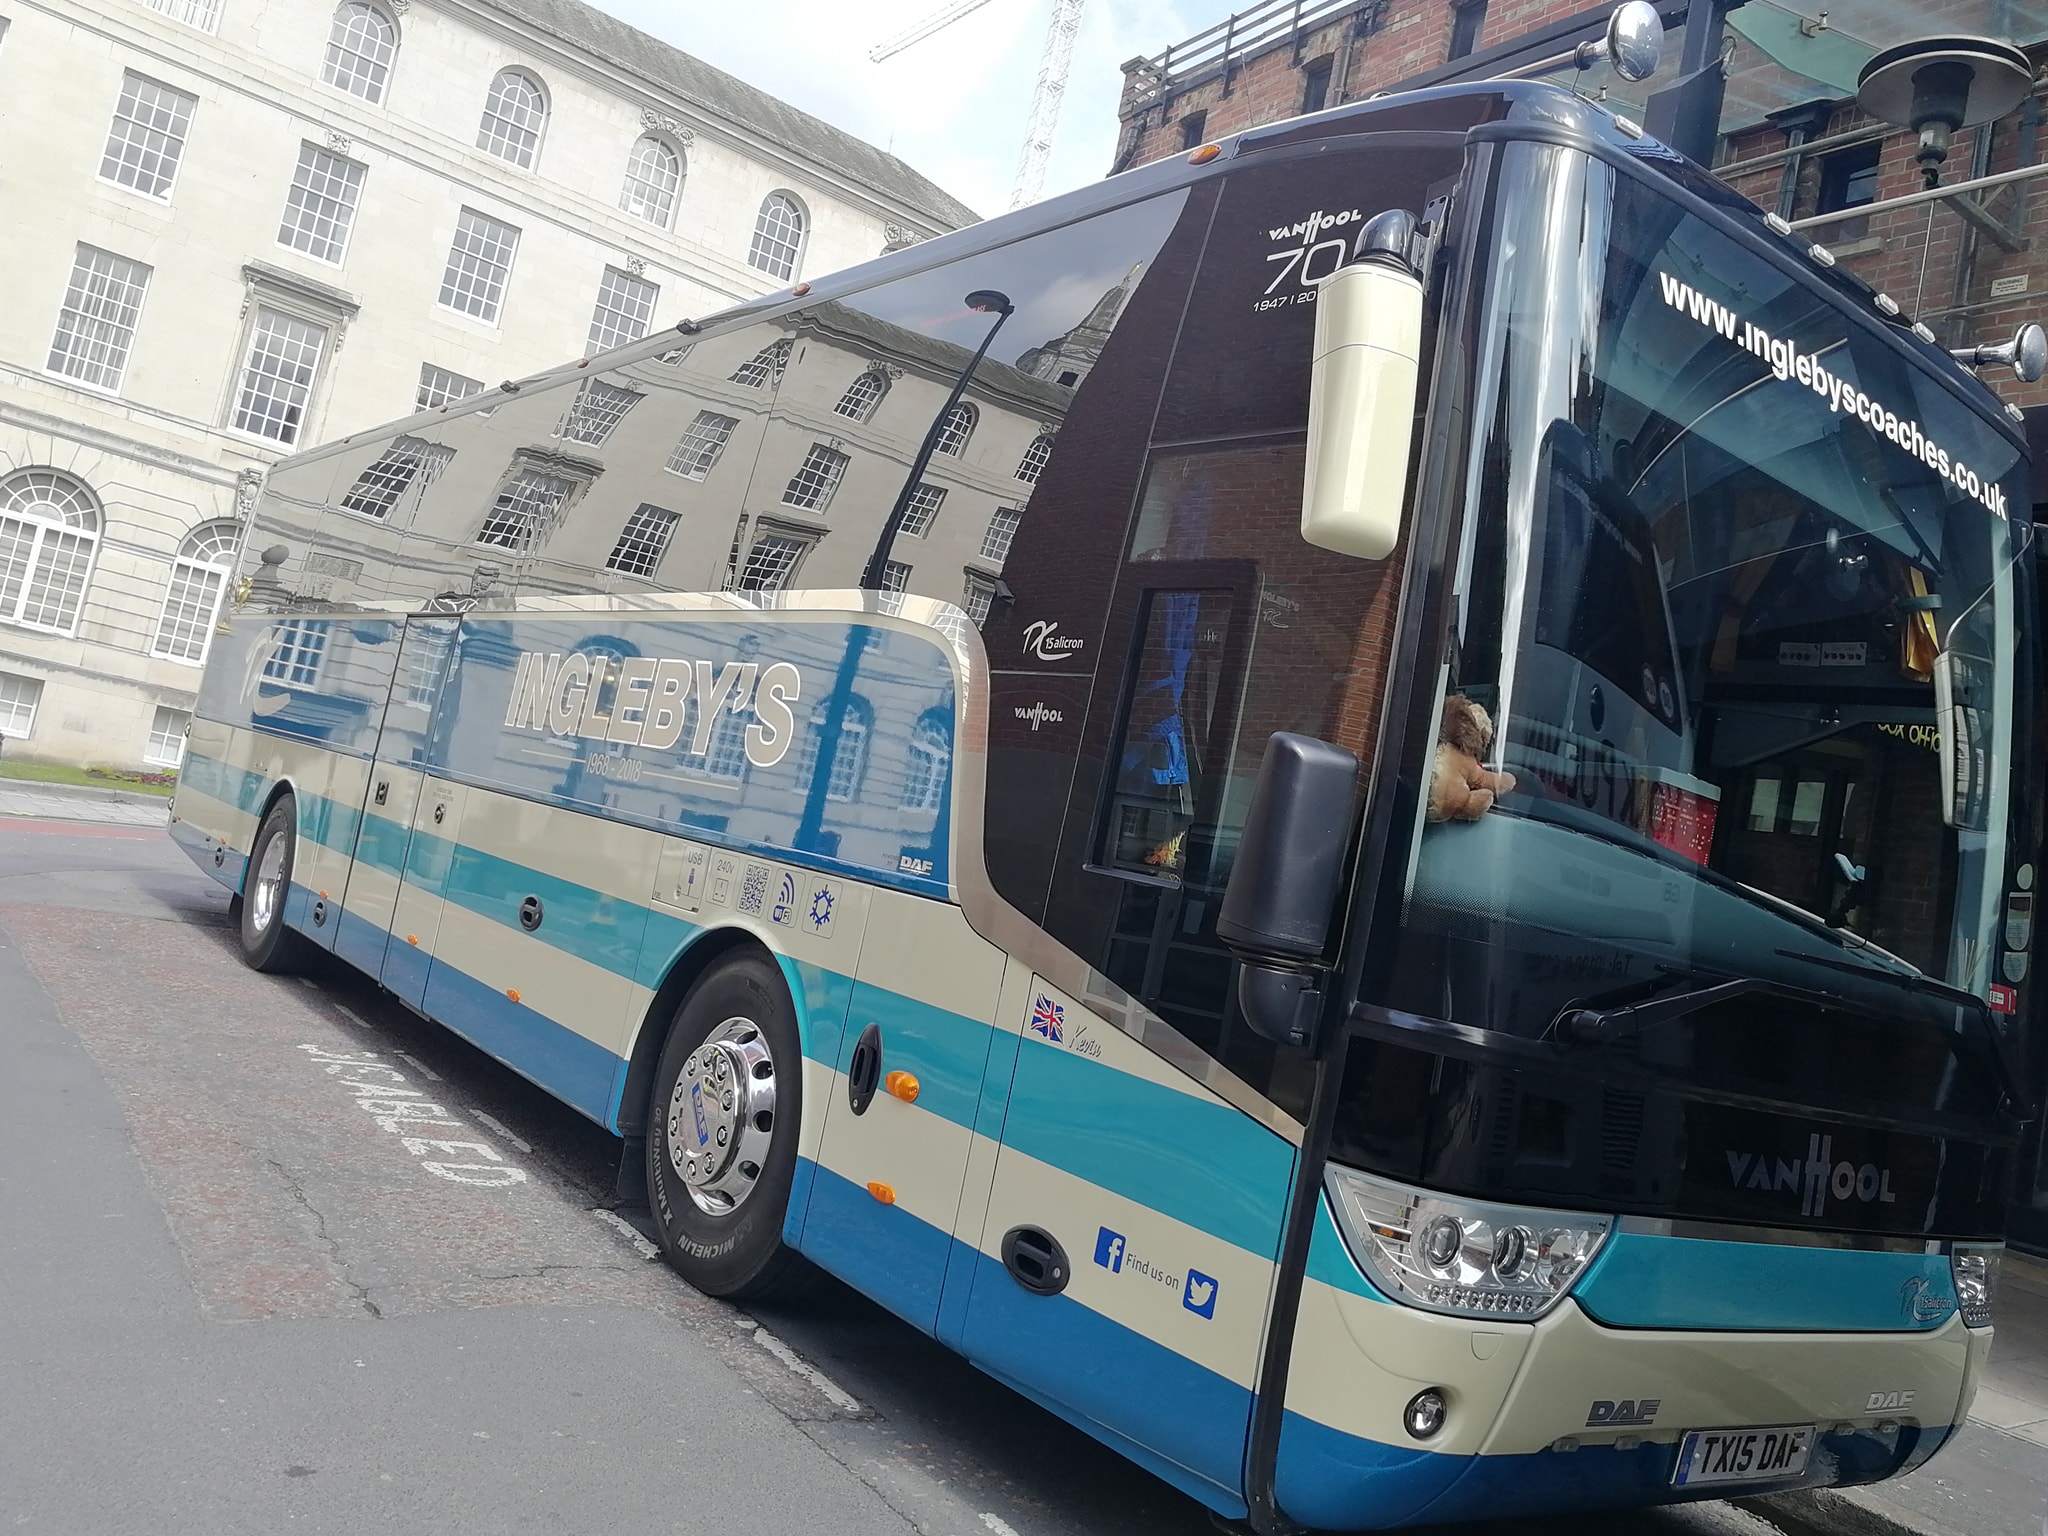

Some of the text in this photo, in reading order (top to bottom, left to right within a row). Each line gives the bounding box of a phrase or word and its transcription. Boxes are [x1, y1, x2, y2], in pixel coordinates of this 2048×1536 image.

[1264, 238, 1346, 295] 70
[1252, 296, 1287, 312] 1947
[1297, 291, 1317, 304] 20
[504, 652, 801, 767] INGLEBY'S
[1909, 725, 1942, 753] OFFIC
[586, 752, 610, 776] 1968
[617, 757, 642, 782] 2018
[688, 851, 704, 865] USB
[900, 855, 933, 873] DAF
[1069, 1024, 1102, 1057] Kevin
[677, 1234, 735, 1259] MICHELIN
[1126, 1253, 1150, 1275] Find
[1150, 1267, 1164, 1282] us
[1165, 1275, 1179, 1290] on
[1586, 1400, 1661, 1426] DAF
[1864, 1390, 1916, 1413] DAF
[1700, 1431, 1806, 1474] TX15 DAF
